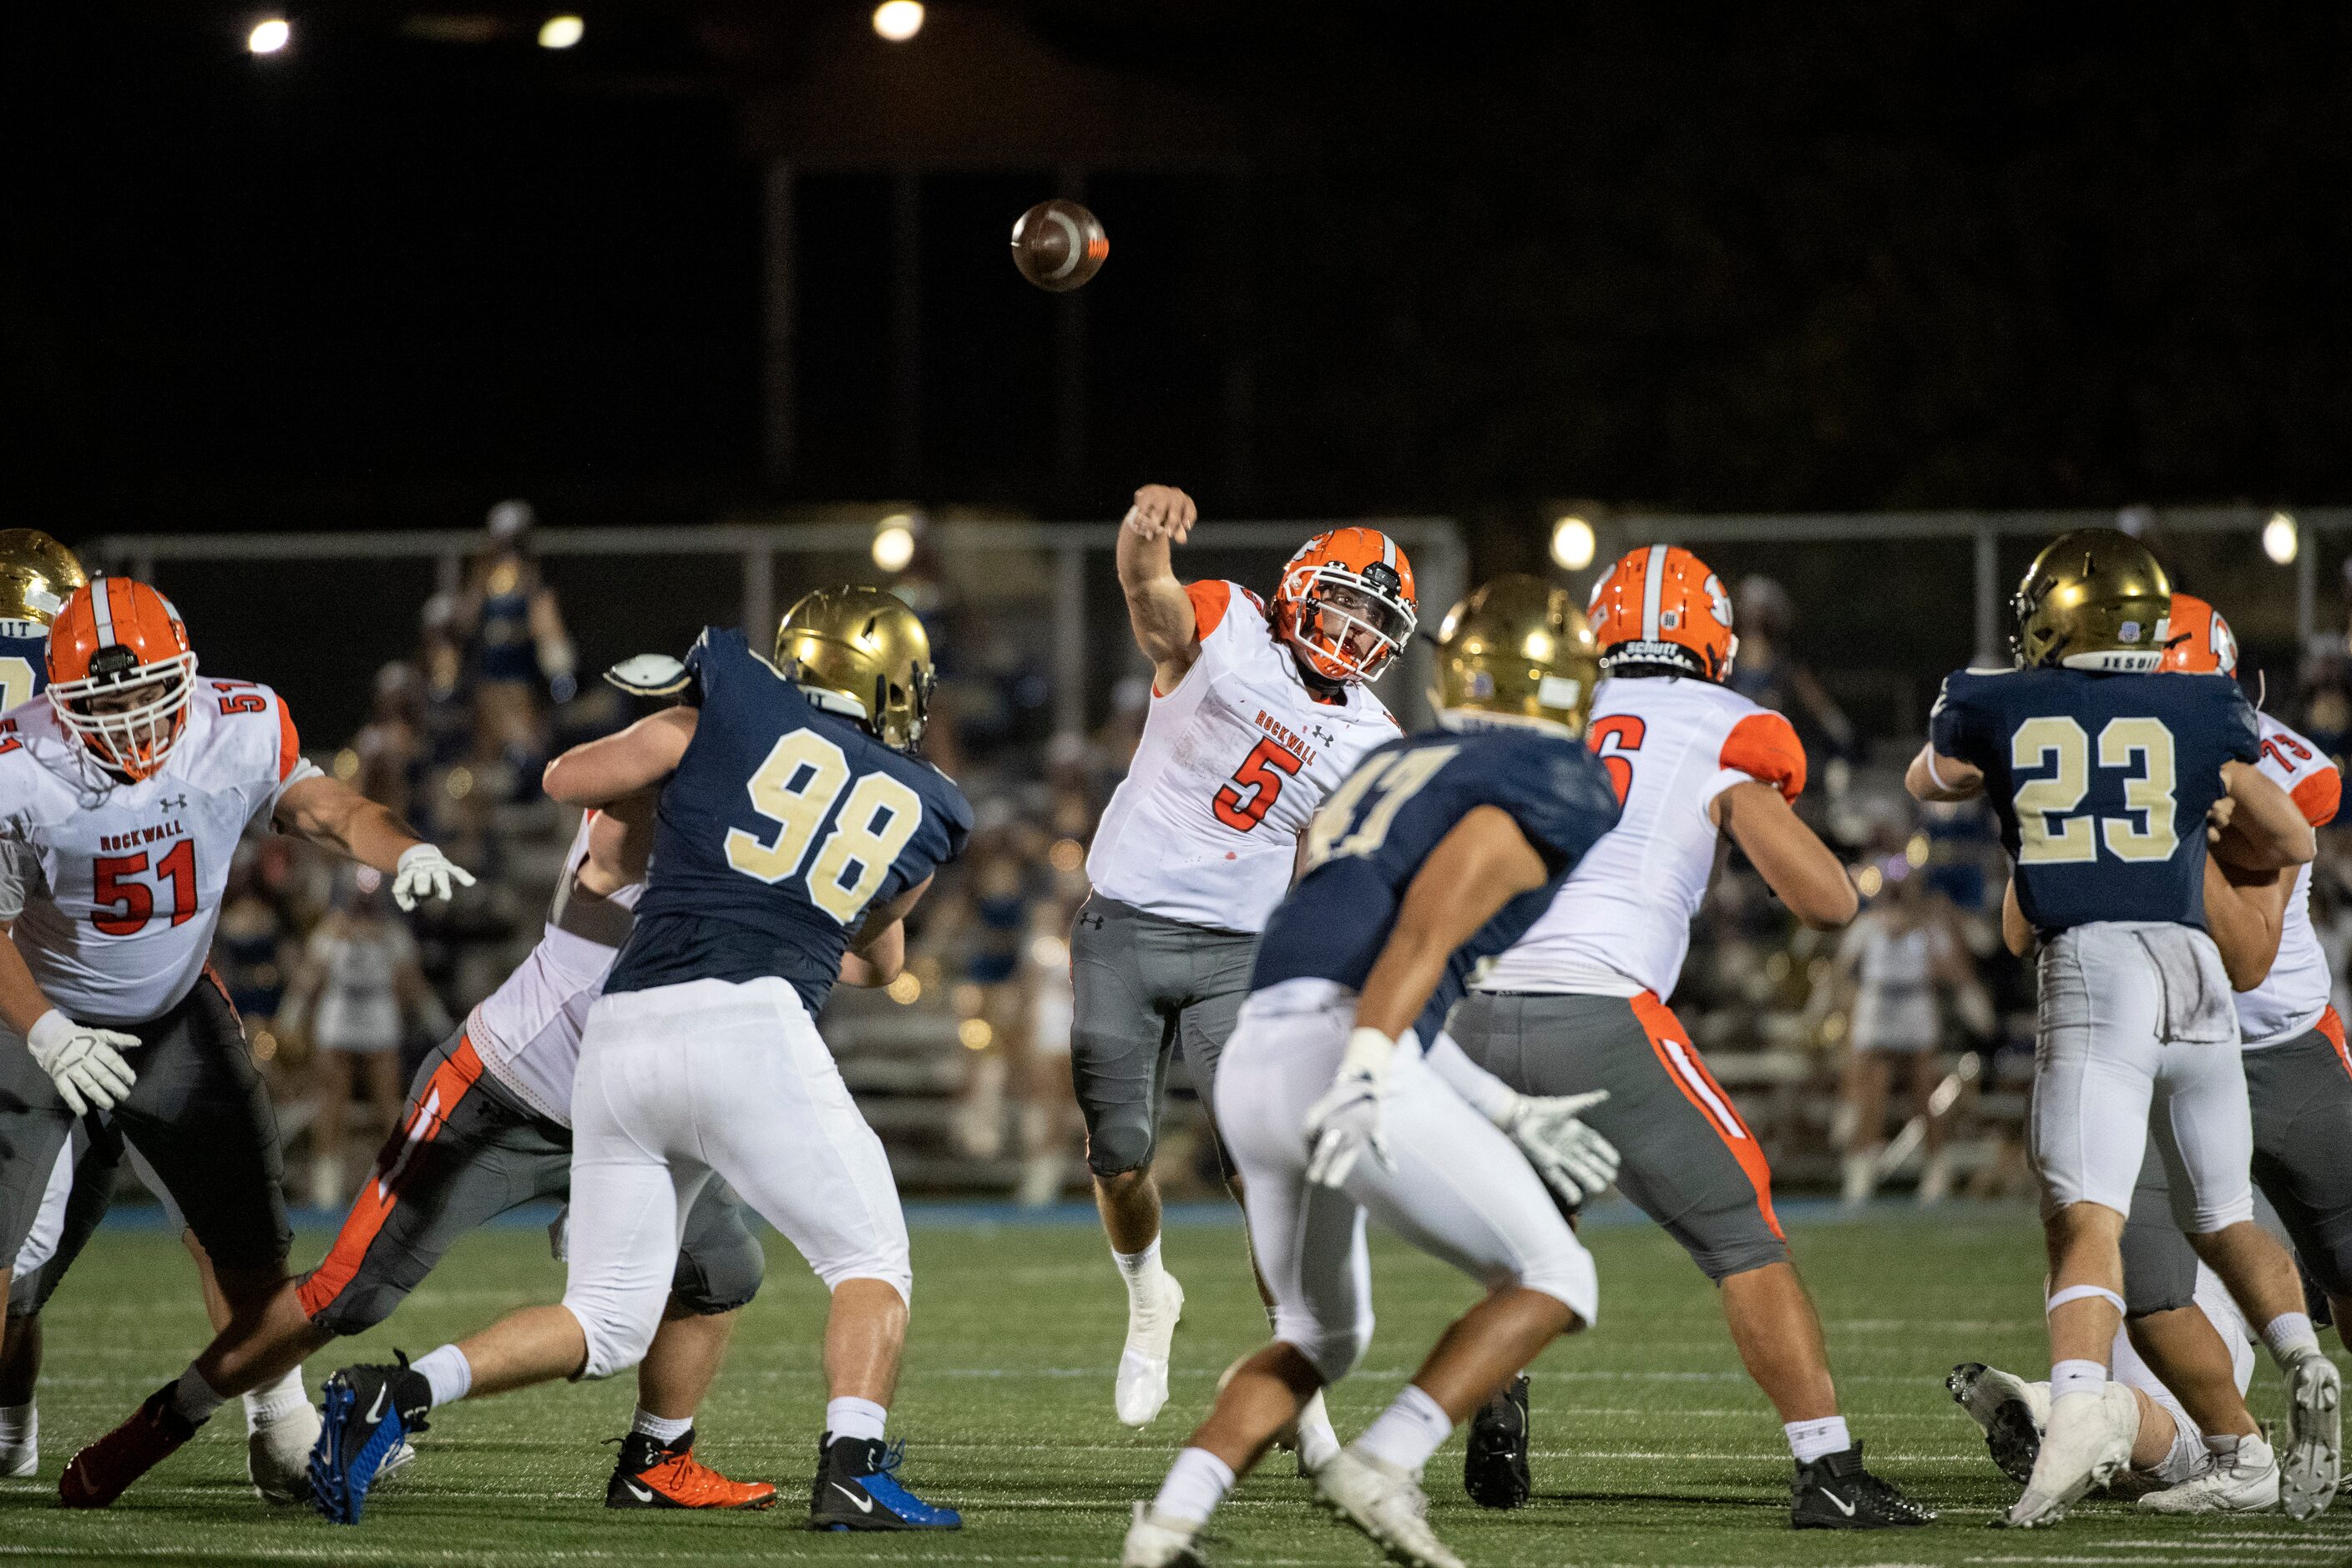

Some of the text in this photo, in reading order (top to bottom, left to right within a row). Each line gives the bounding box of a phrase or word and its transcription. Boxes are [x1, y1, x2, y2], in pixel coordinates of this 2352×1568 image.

[1212, 736, 1304, 832] 5
[1255, 710, 1317, 766] ROCKWALL
[2260, 734, 2312, 773] 73
[99, 819, 184, 851] ROCKWALL
[723, 727, 923, 927] 98
[2011, 716, 2180, 865] 23
[90, 838, 198, 936] 51
